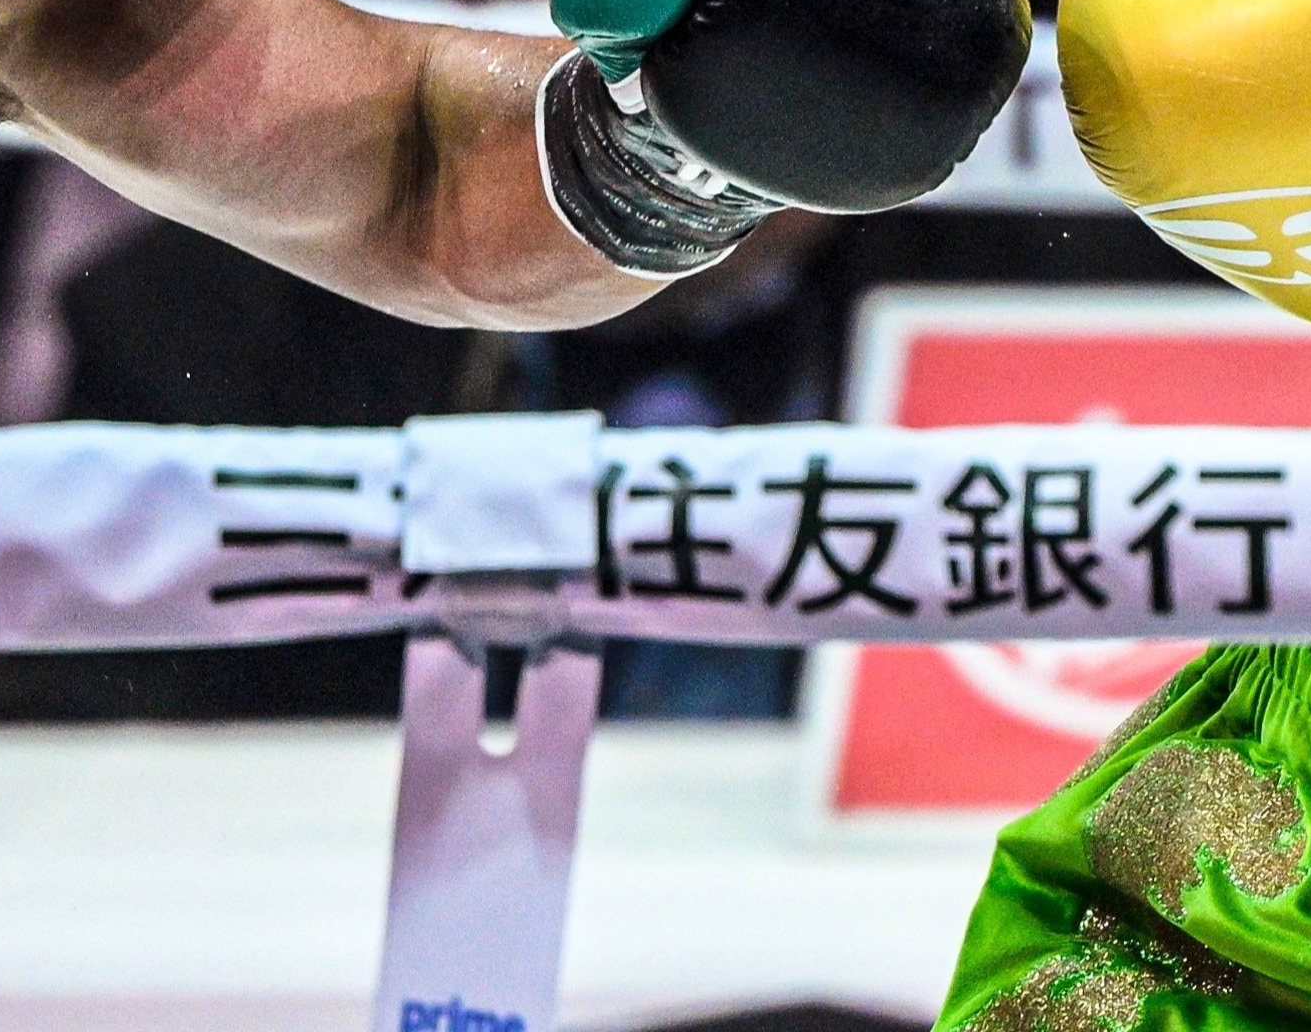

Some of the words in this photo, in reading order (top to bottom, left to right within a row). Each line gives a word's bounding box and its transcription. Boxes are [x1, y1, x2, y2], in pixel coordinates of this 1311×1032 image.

[210, 454, 1294, 618] 三住友銀行
